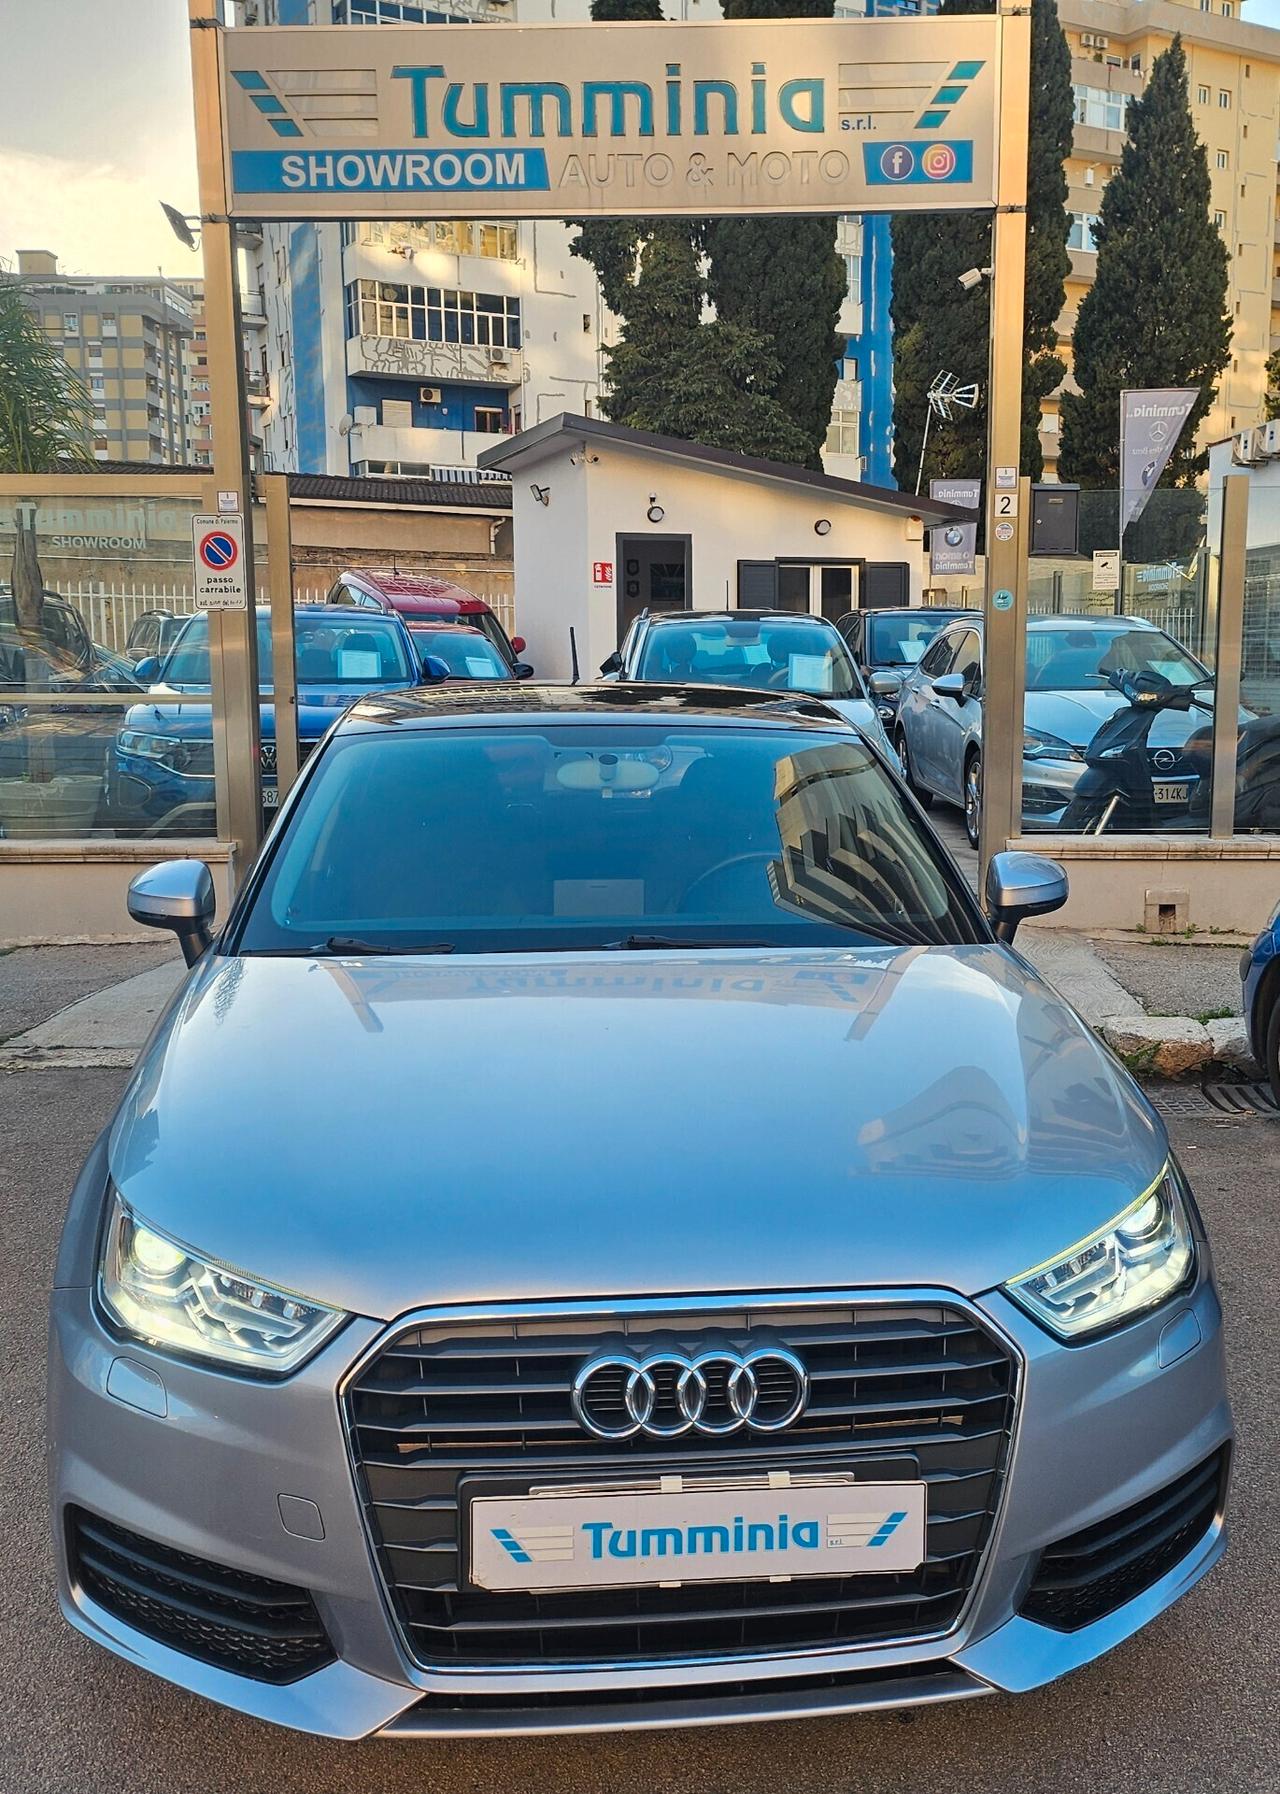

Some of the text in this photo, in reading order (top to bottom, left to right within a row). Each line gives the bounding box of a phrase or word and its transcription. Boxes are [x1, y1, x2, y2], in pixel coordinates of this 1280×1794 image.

[390, 62, 877, 138] Tumminia s.r.l.
[281, 150, 850, 188] SHOWROOM AUTO & MOTO
[1000, 496, 1011, 514] 2
[52, 535, 147, 550] SHOWROOM
[582, 1514, 819, 1559] Tumminia
